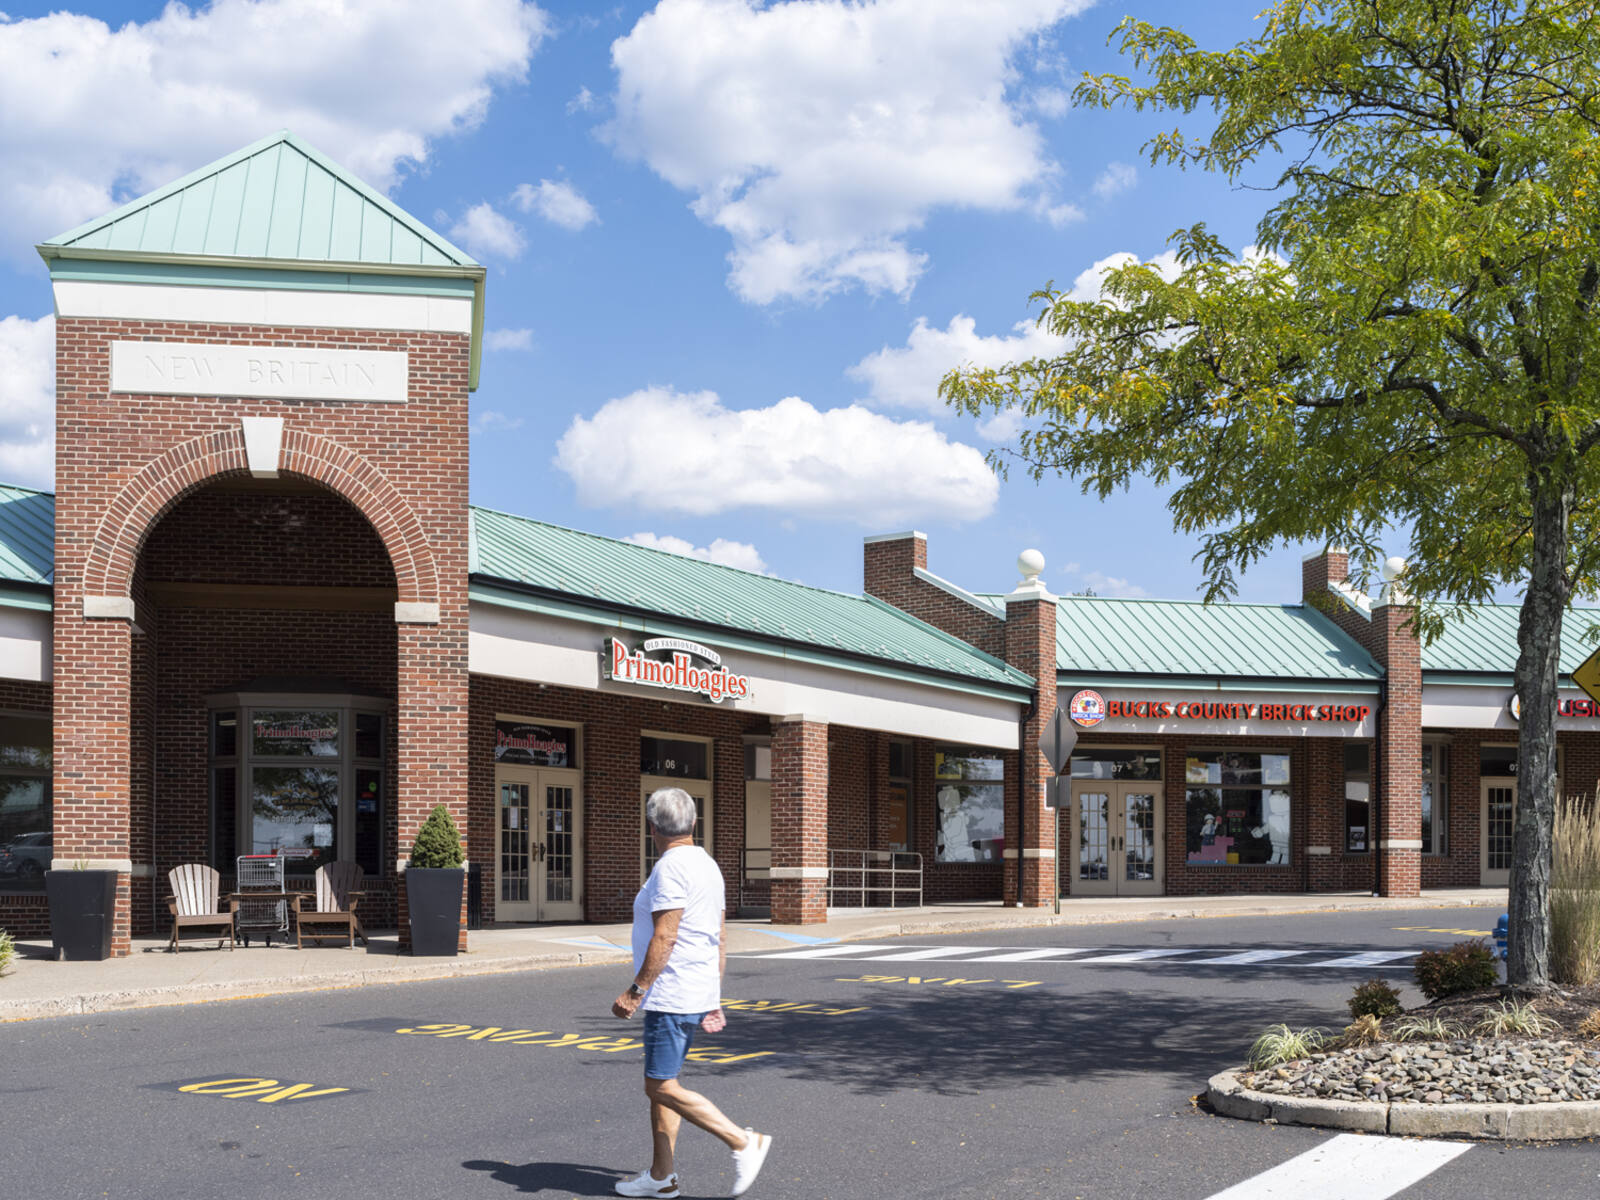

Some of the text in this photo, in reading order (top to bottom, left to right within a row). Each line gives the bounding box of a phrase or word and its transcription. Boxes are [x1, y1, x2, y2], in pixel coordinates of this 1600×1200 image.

[144, 354, 376, 386] NEW BRITAIN
[645, 641, 659, 650] OLD
[661, 640, 698, 652] FASHIONED
[613, 640, 747, 699] PrimoHoagies
[1108, 701, 1370, 722] BUCKS COUNTY BRICK SHOP
[1557, 699, 1600, 717] USI
[665, 759, 676, 769] 06
[834, 975, 1045, 989] LANE
[177, 1077, 351, 1103] NO
